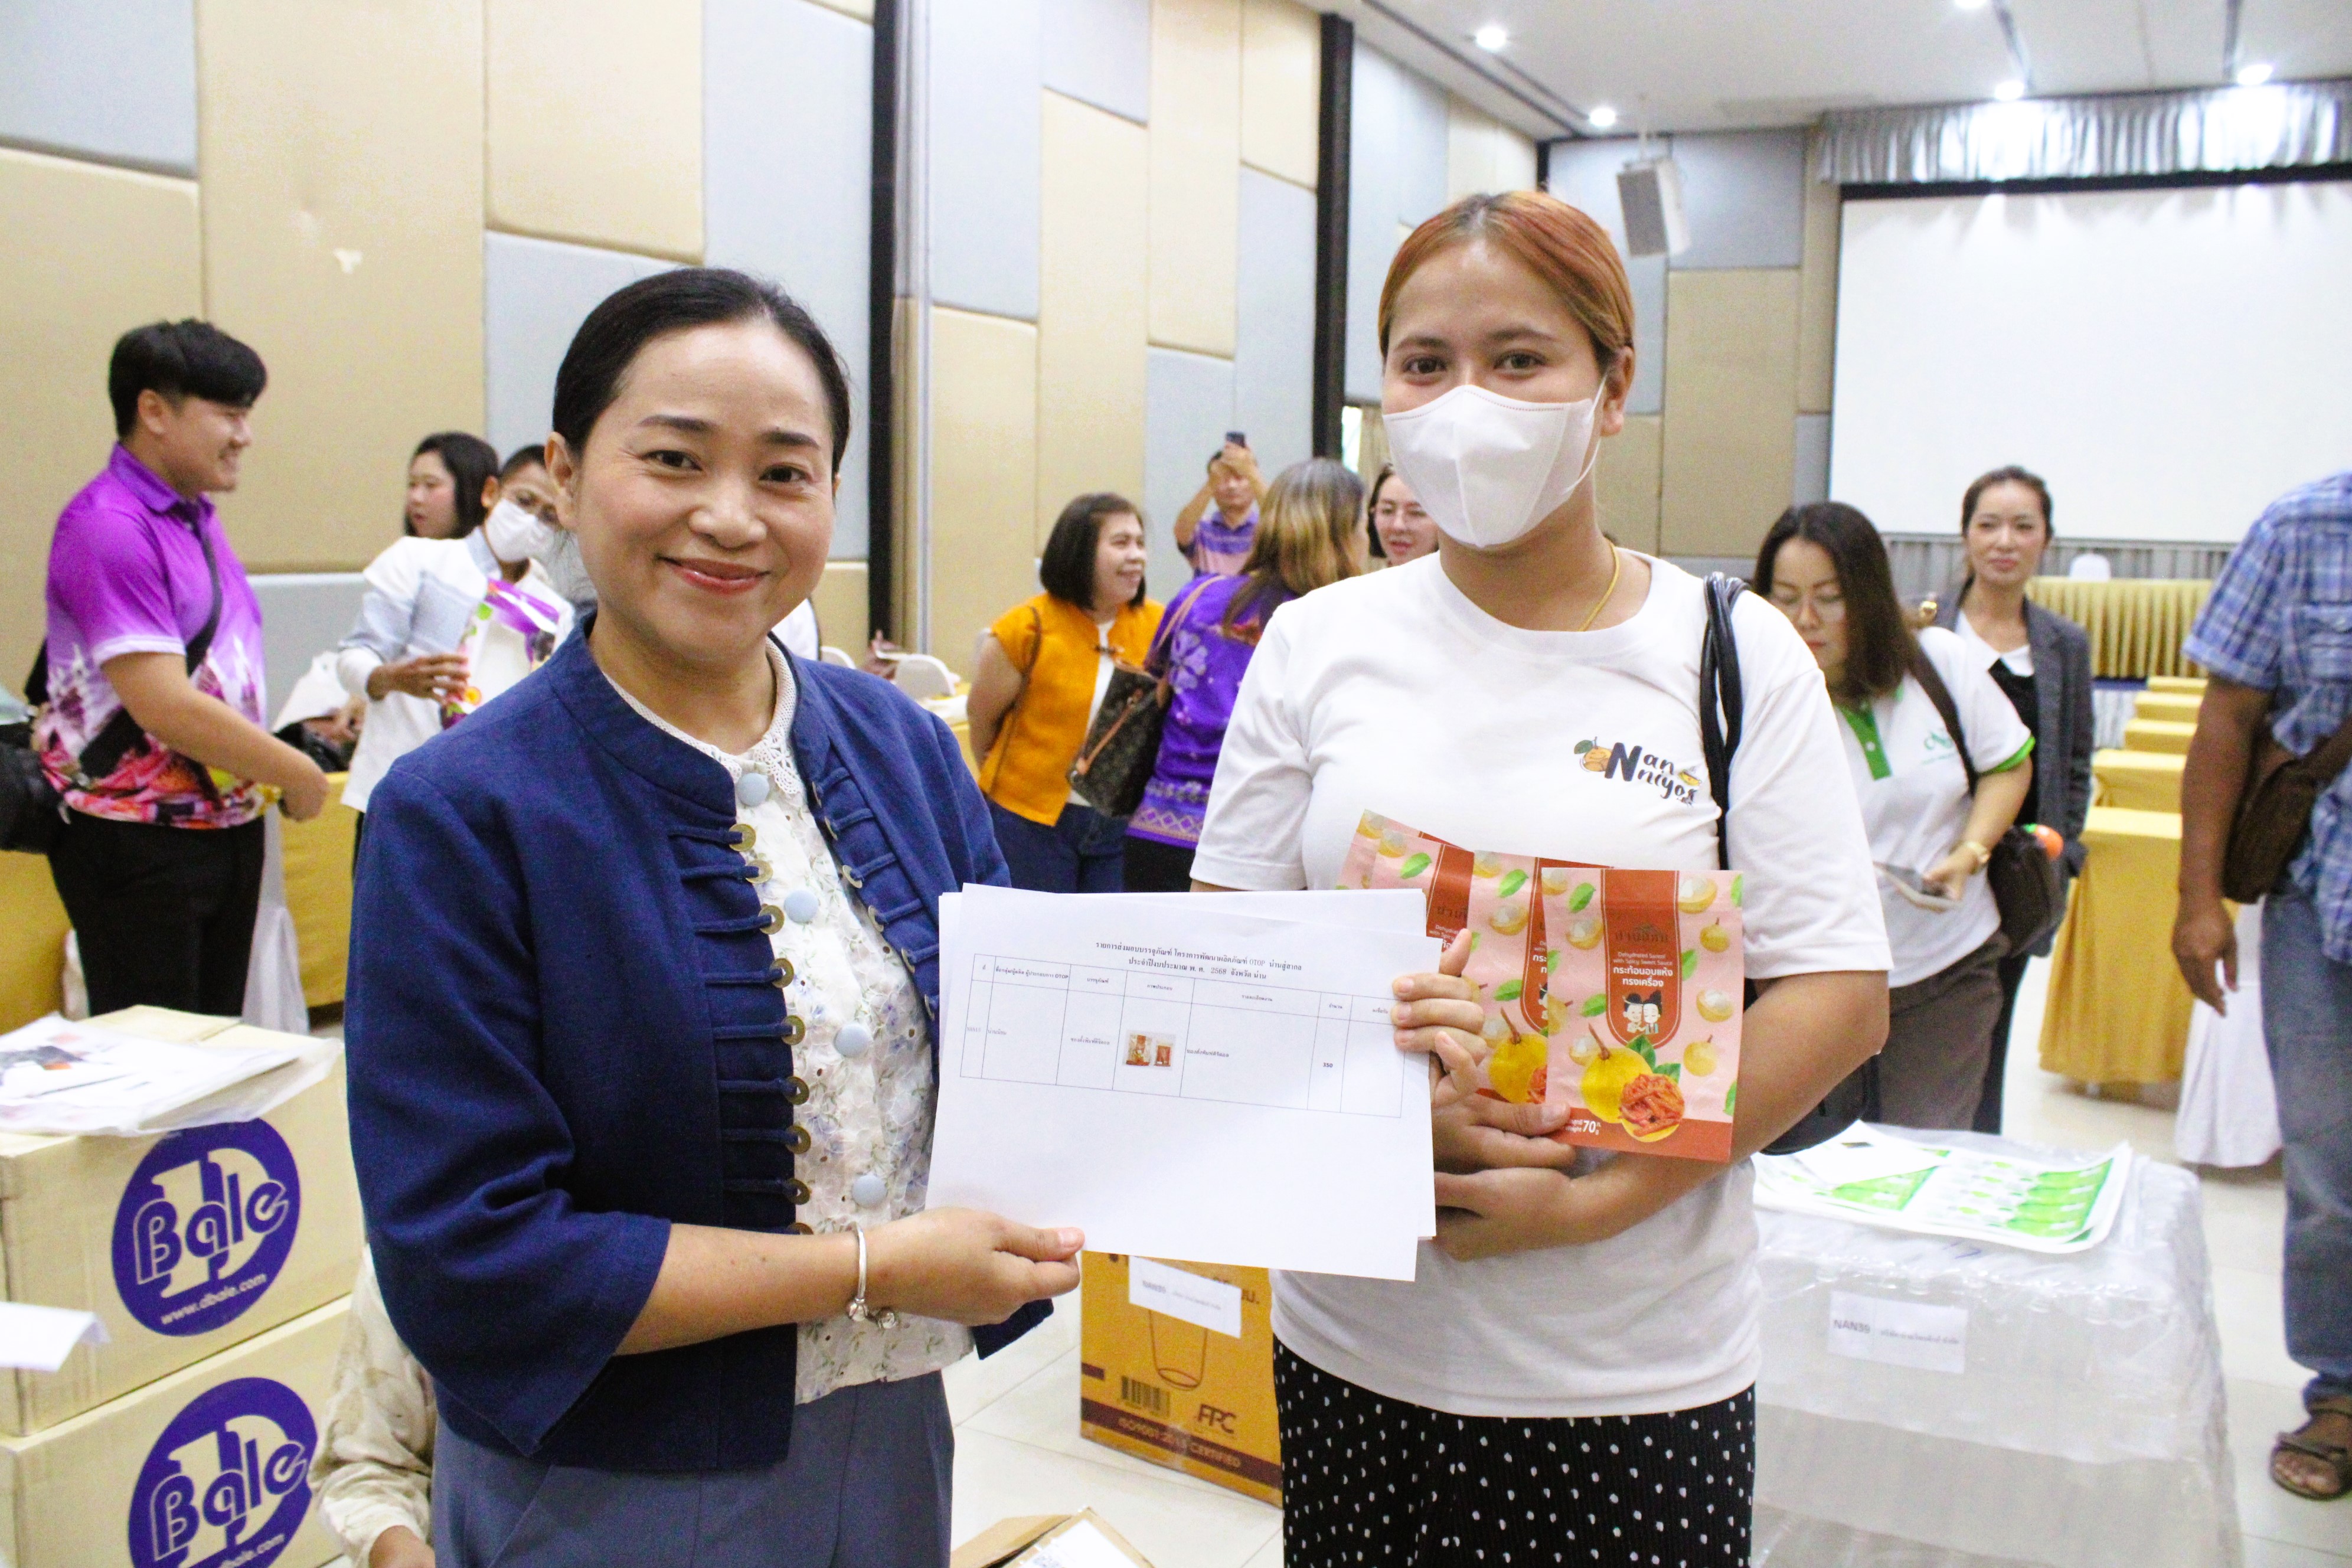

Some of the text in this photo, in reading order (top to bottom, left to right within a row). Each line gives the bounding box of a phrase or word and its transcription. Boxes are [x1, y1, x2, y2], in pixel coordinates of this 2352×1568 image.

[1128, 957, 1187, 971] ประจำปีงบประมาณ
[1231, 968, 1252, 978] จังหวัด
[1254, 970, 1266, 979] น่าน
[1269, 959, 1302, 971] น่านสู่สากล
[1613, 965, 1673, 976] กระท้อนอบแห้ง
[1622, 975, 1664, 987] ทรงเครื่อง
[1582, 1120, 1596, 1133] 70
[133, 1174, 289, 1285] Bale
[150, 1439, 309, 1562] Bale
